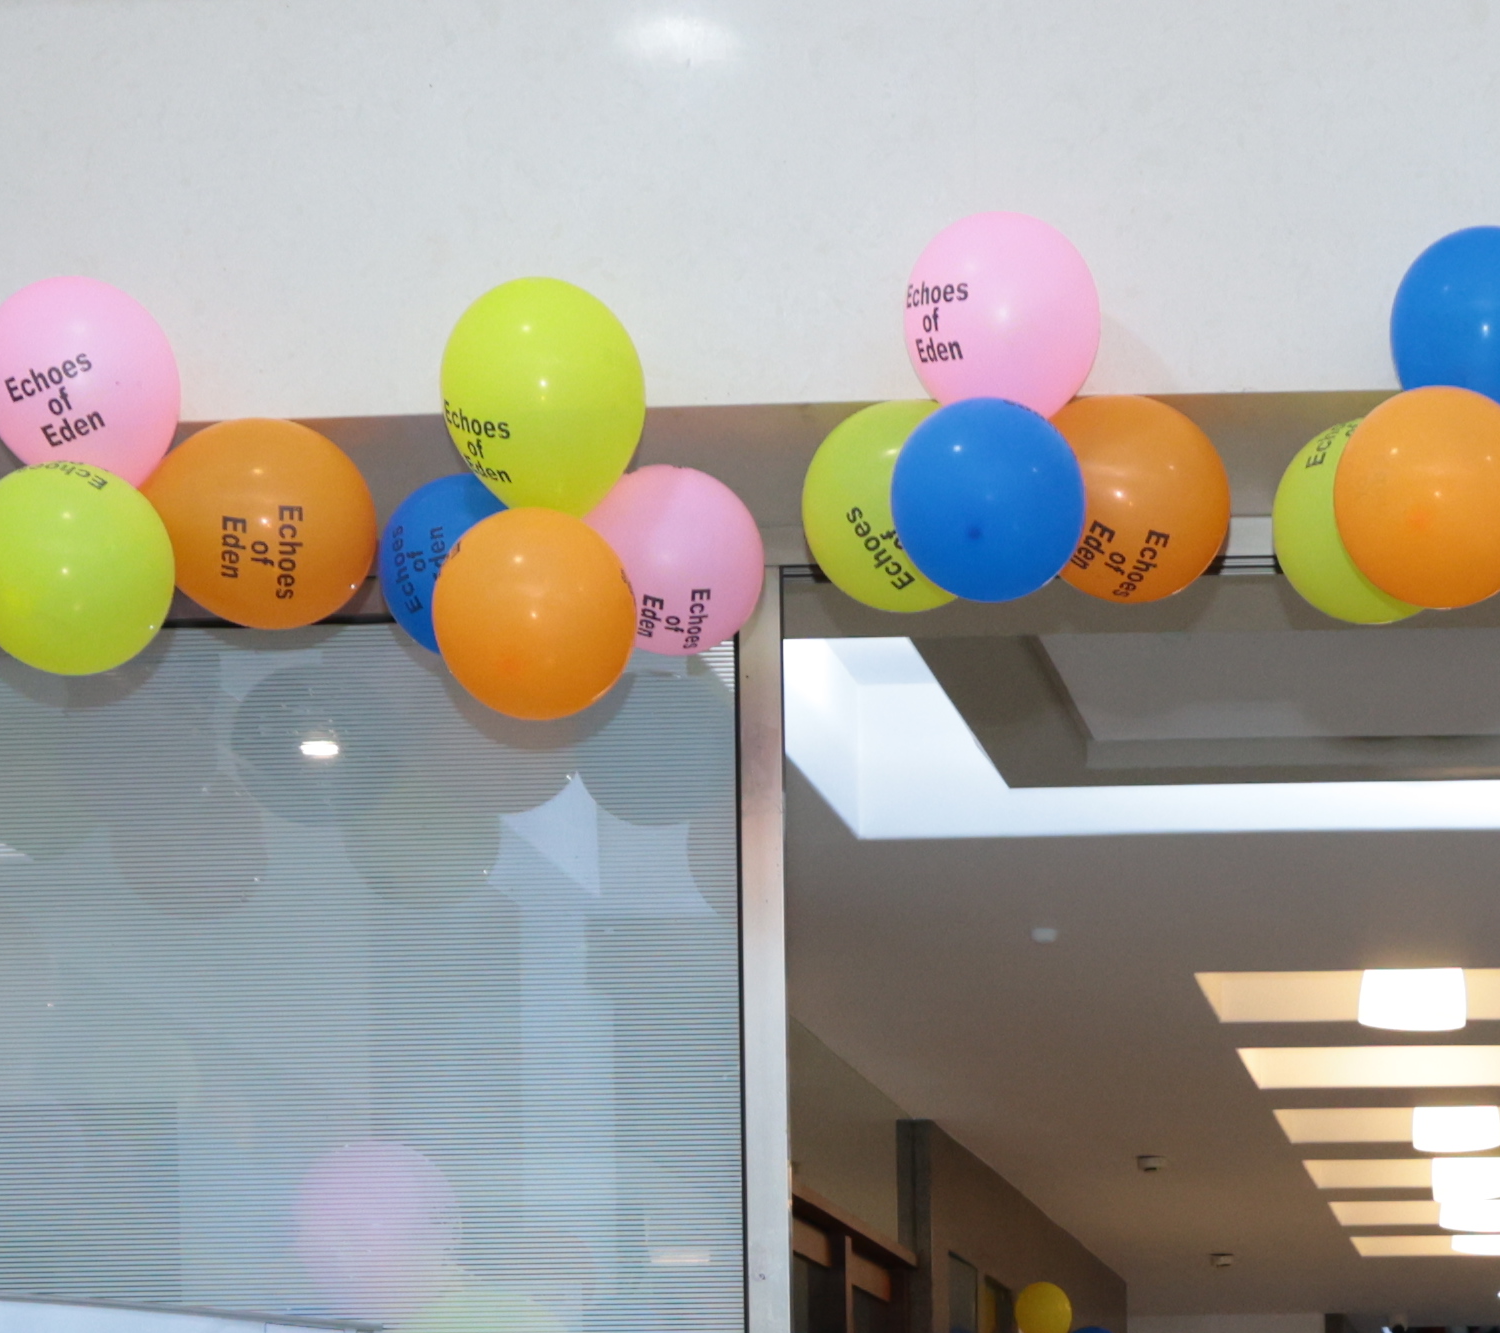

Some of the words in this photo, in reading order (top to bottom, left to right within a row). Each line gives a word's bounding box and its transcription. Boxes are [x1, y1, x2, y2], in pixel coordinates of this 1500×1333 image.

[907, 279, 969, 309] Echoes
[922, 307, 940, 333] of
[916, 339, 962, 363] Eden
[4, 350, 92, 404] Echoes
[47, 387, 73, 415] of
[40, 408, 105, 449] Eden
[443, 399, 510, 440] Echoes
[467, 439, 485, 459] of
[465, 456, 511, 483] Eden
[220, 515, 247, 579] Eden
[252, 540, 274, 566] of
[276, 504, 304, 601] Echoes
